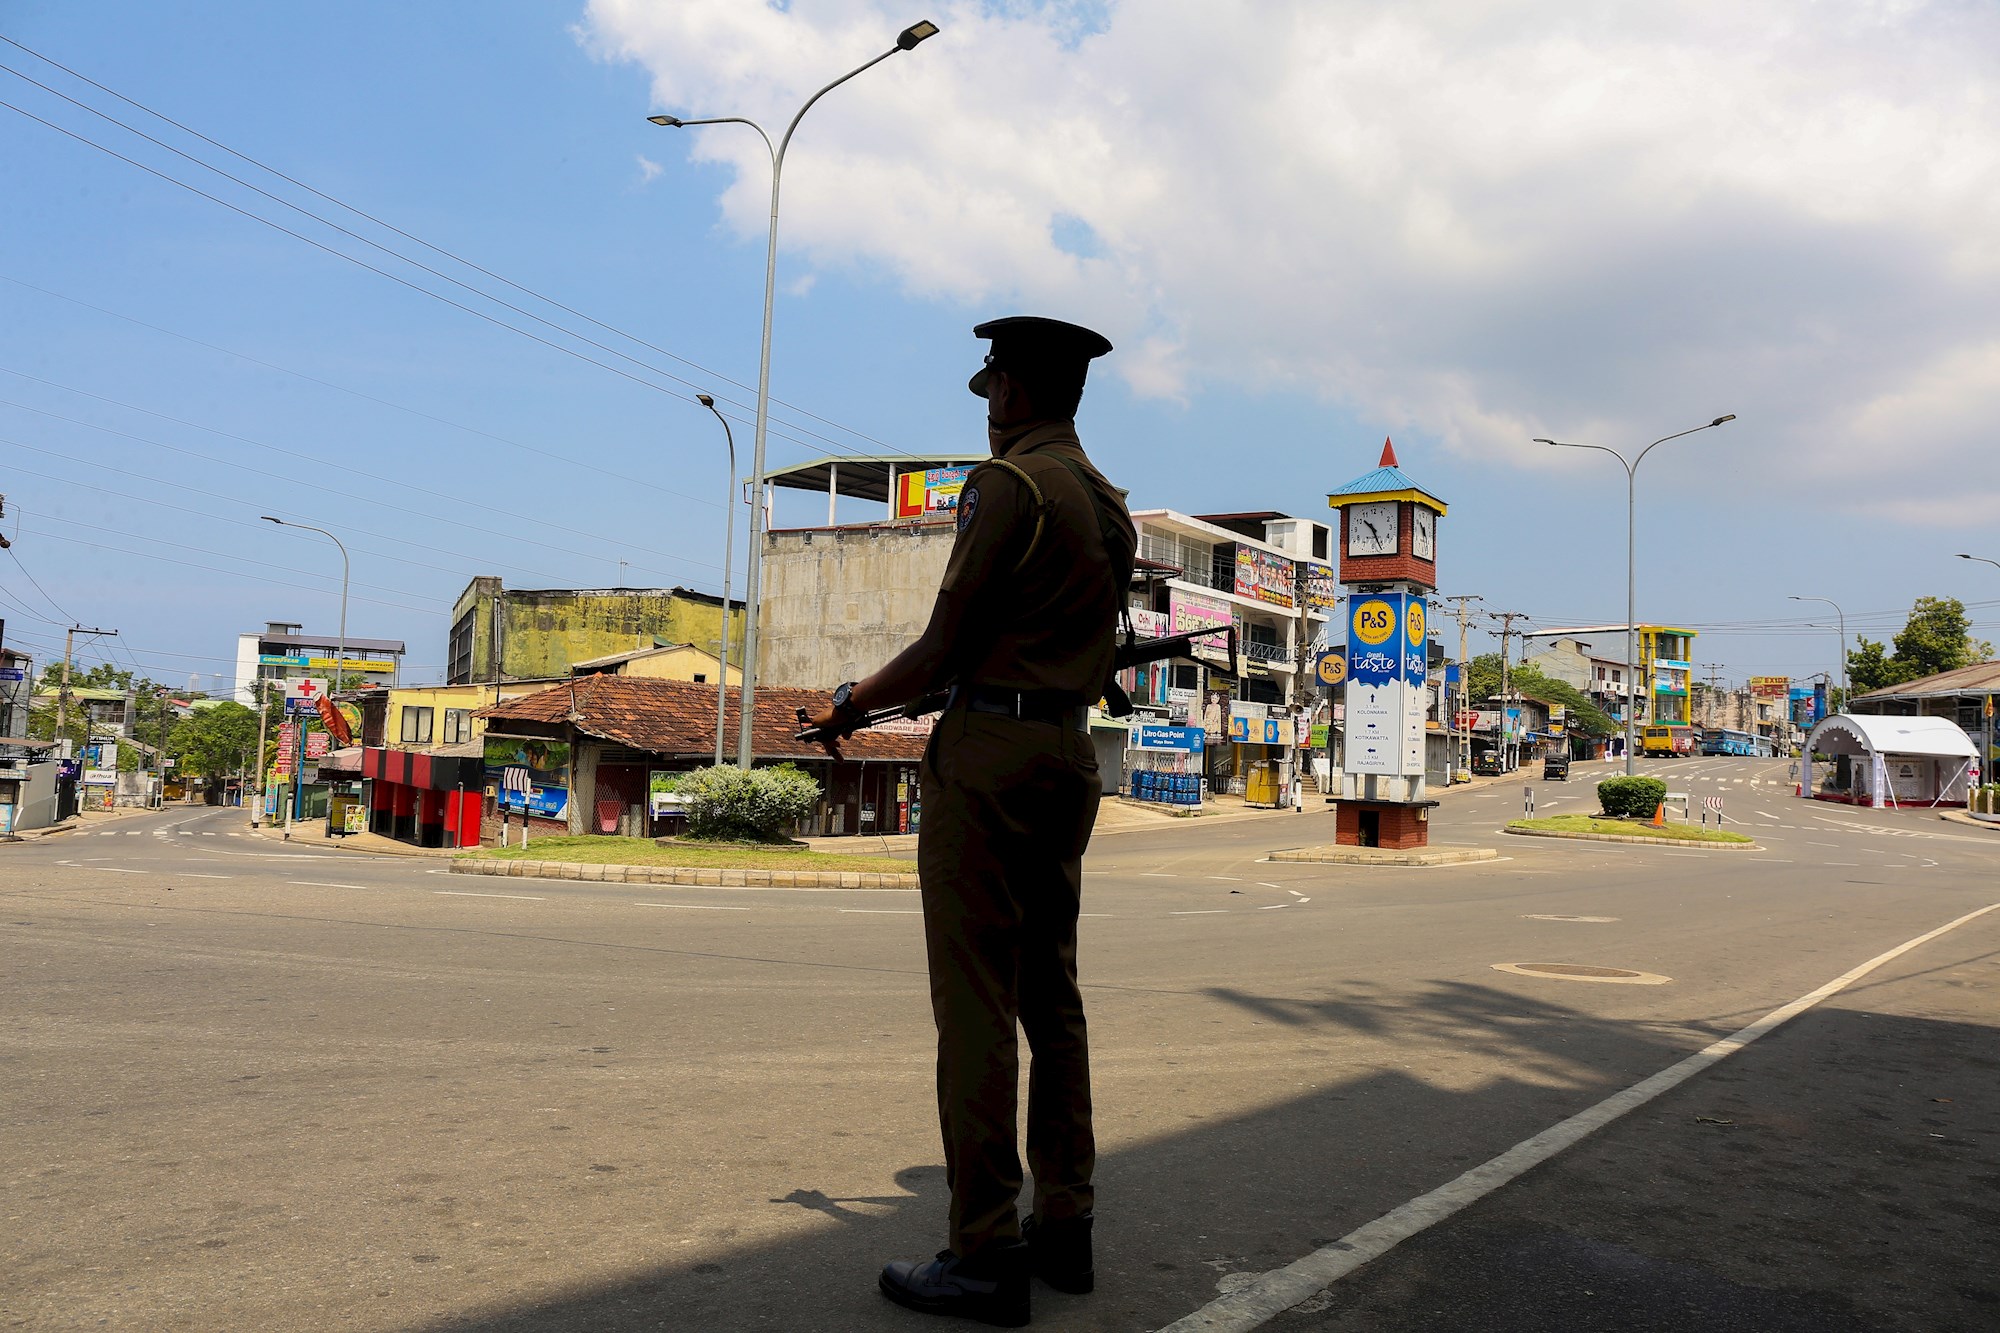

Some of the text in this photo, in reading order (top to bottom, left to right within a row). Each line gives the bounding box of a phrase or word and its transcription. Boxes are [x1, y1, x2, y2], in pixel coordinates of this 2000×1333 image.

[900, 475, 922, 517] L
[925, 489, 936, 510] L
[1361, 610, 1387, 629] P&S
[1410, 612, 1422, 631] P&S
[263, 656, 299, 664] GOODYEAR
[1324, 662, 1341, 675] P&S
[1351, 652, 1396, 673] taste
[1406, 653, 1425, 674] taste
[1764, 676, 1789, 684] EXIDE
[873, 724, 913, 732] HARDWARE
[1143, 729, 1185, 739] Litro Gas Point
